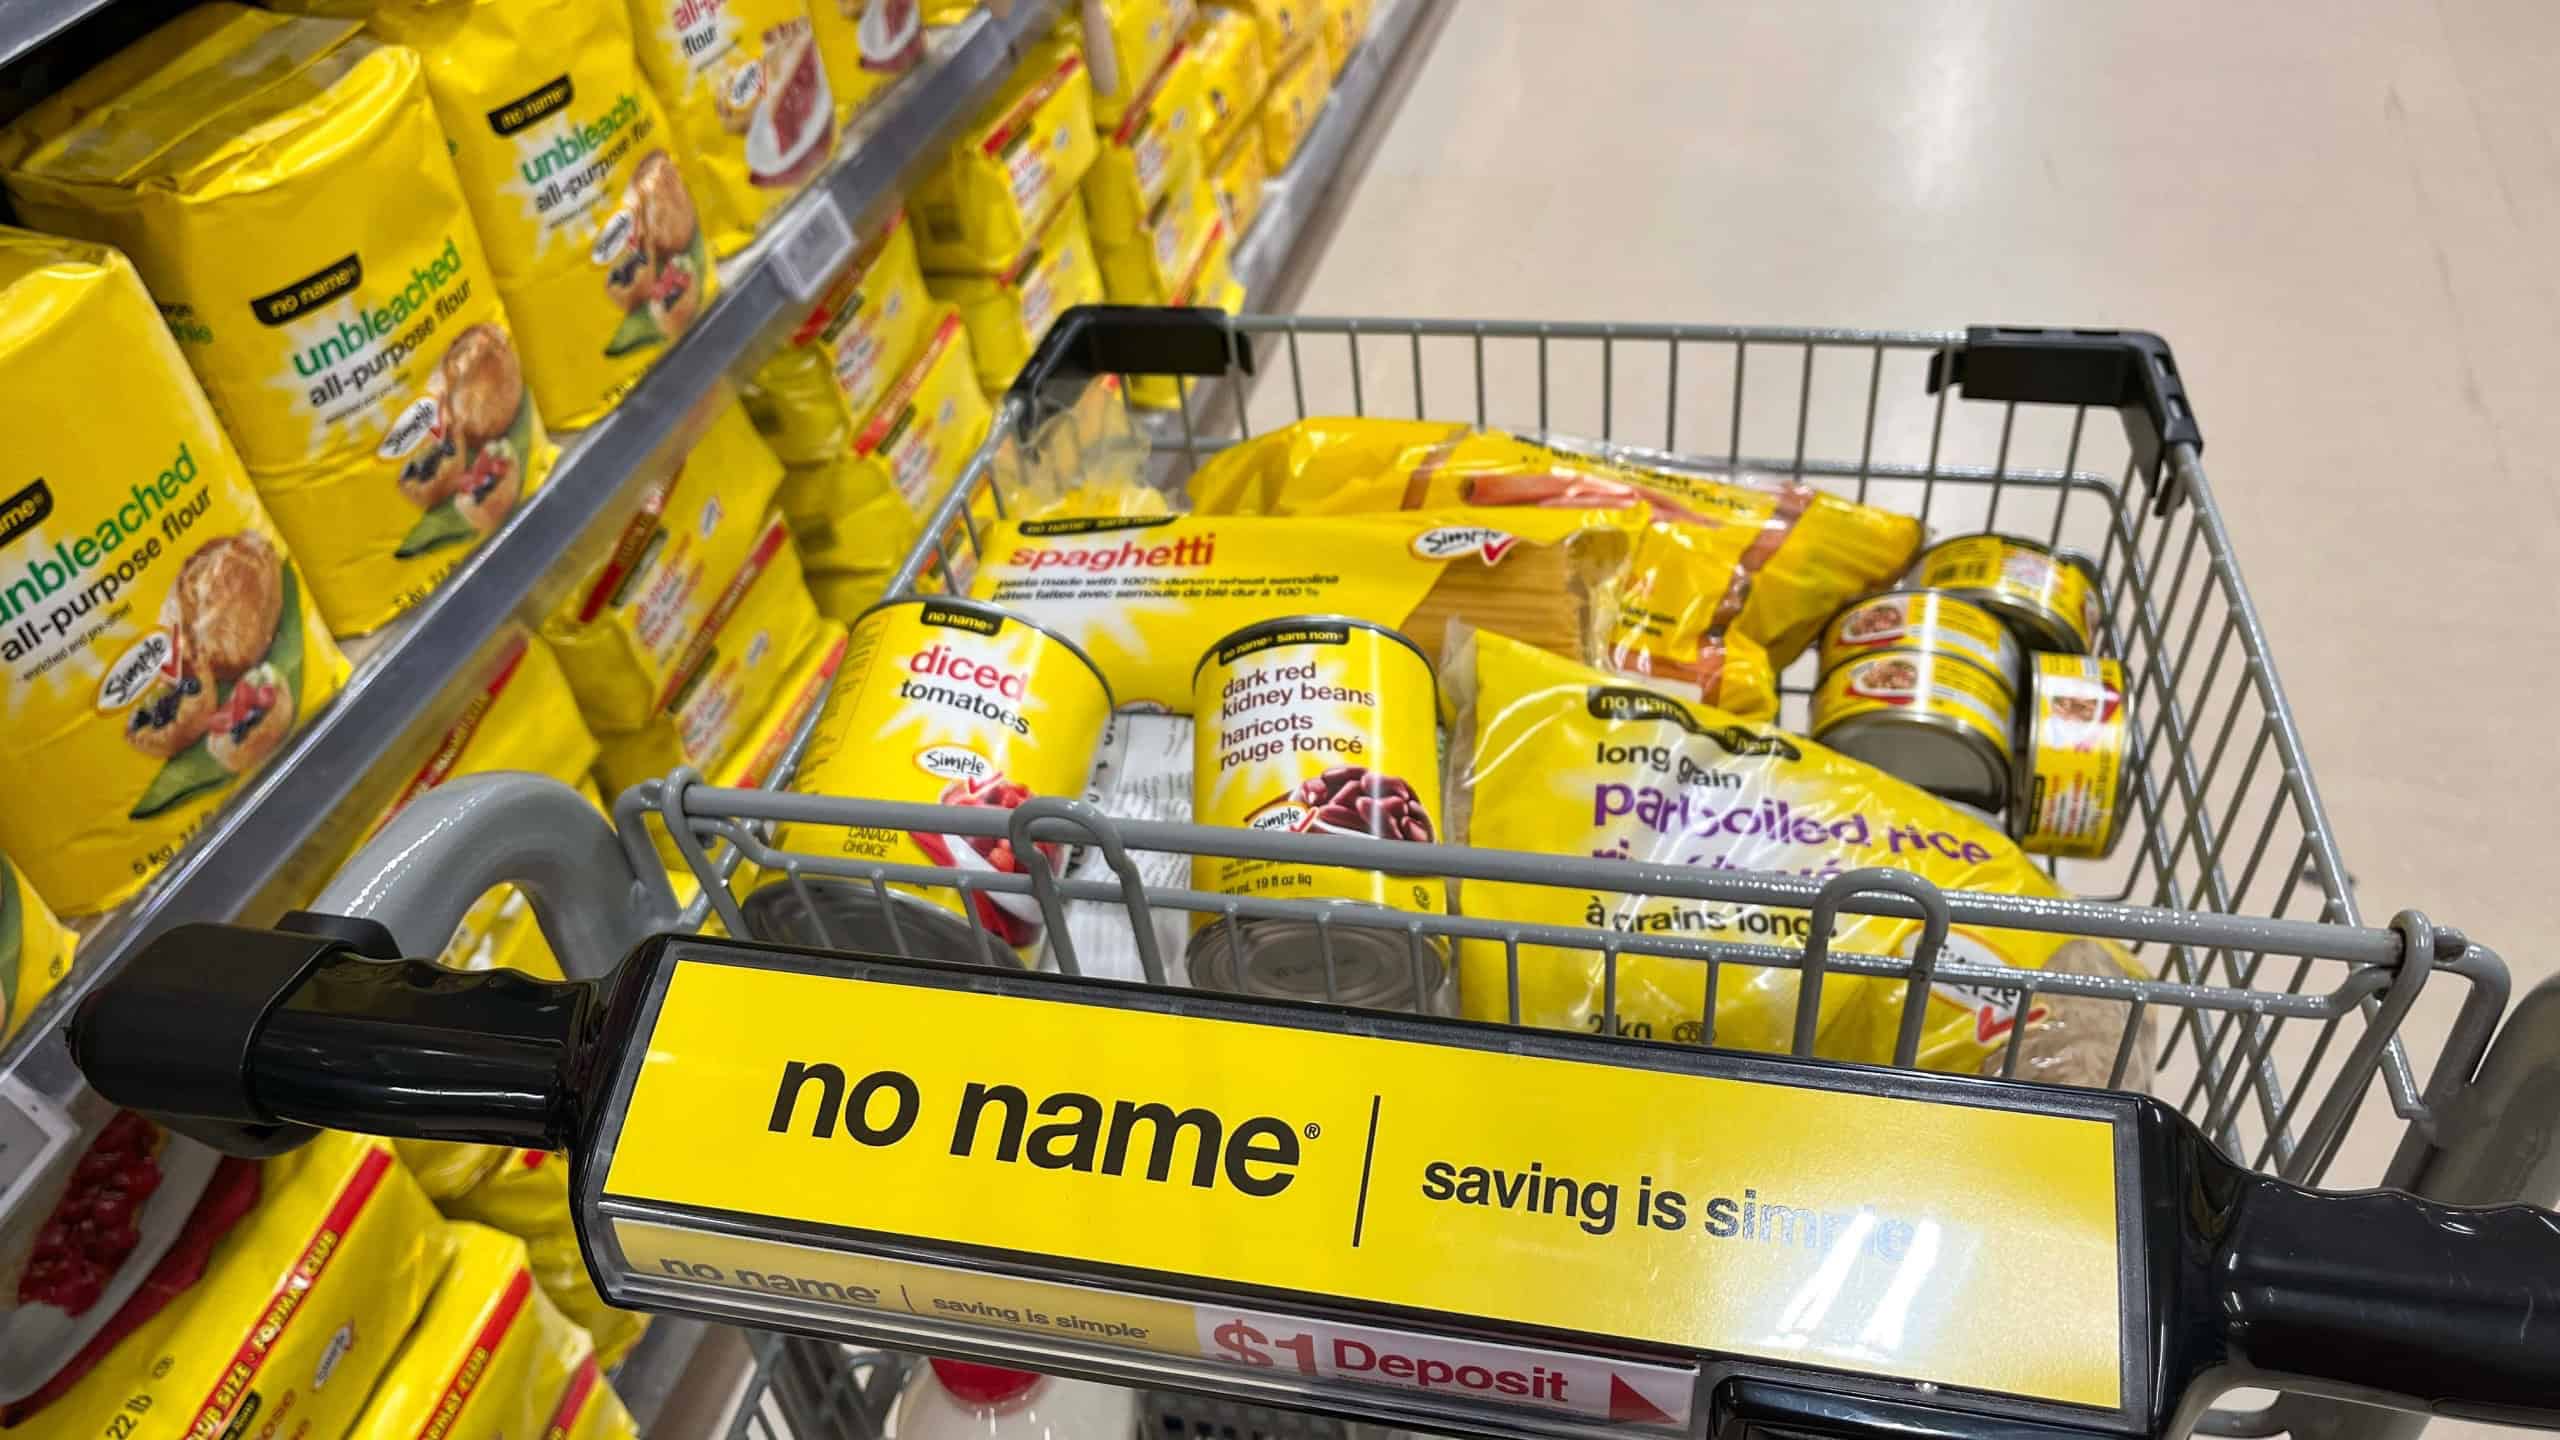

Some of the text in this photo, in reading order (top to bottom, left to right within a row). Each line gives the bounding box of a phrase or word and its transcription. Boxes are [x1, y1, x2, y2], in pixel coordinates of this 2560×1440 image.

[269, 295, 300, 318] no
[292, 236, 463, 378] unbleached
[309, 315, 436, 409] all-purpose
[434, 279, 472, 323] flour
[1008, 531, 1217, 573] spaghetti
[4, 485, 212, 664] all-purpose flour
[1041, 576, 1084, 587] made
[1085, 575, 1118, 586] with
[1164, 576, 1215, 586] durum
[1218, 575, 1267, 586] wheat
[1269, 573, 1340, 585] semolina
[1077, 588, 1114, 599] avec
[1115, 587, 1182, 598] semoule
[1183, 587, 1202, 598] de
[1275, 587, 1303, 598] 100
[927, 611, 946, 622] no
[1276, 630, 1308, 643] sans
[104, 635, 166, 704] Simple
[909, 643, 1028, 702] diced
[1221, 660, 1317, 699] dark red
[900, 678, 1030, 736] tomatoes
[1221, 681, 1376, 721] kidney beans
[1600, 694, 1630, 710] no
[1220, 711, 1315, 750] haricots
[926, 750, 985, 773] Simple
[1219, 732, 1364, 772] rouge foncé
[1596, 741, 1671, 773] long
[1252, 808, 1301, 832] Simple
[1886, 822, 1993, 865] rice
[1585, 895, 1838, 947] à grains long
[766, 1060, 920, 1148] no
[1421, 1159, 1618, 1235] saving
[1636, 1175, 1687, 1232] is
[659, 1257, 725, 1281] no
[932, 1296, 1020, 1324] saving
[1027, 1308, 1050, 1325] is
[215, 1360, 252, 1408] SIZE
[304, 1228, 339, 1277] CLUB
[1212, 1318, 1319, 1377] $1
[1331, 1337, 1569, 1402] Deposit
